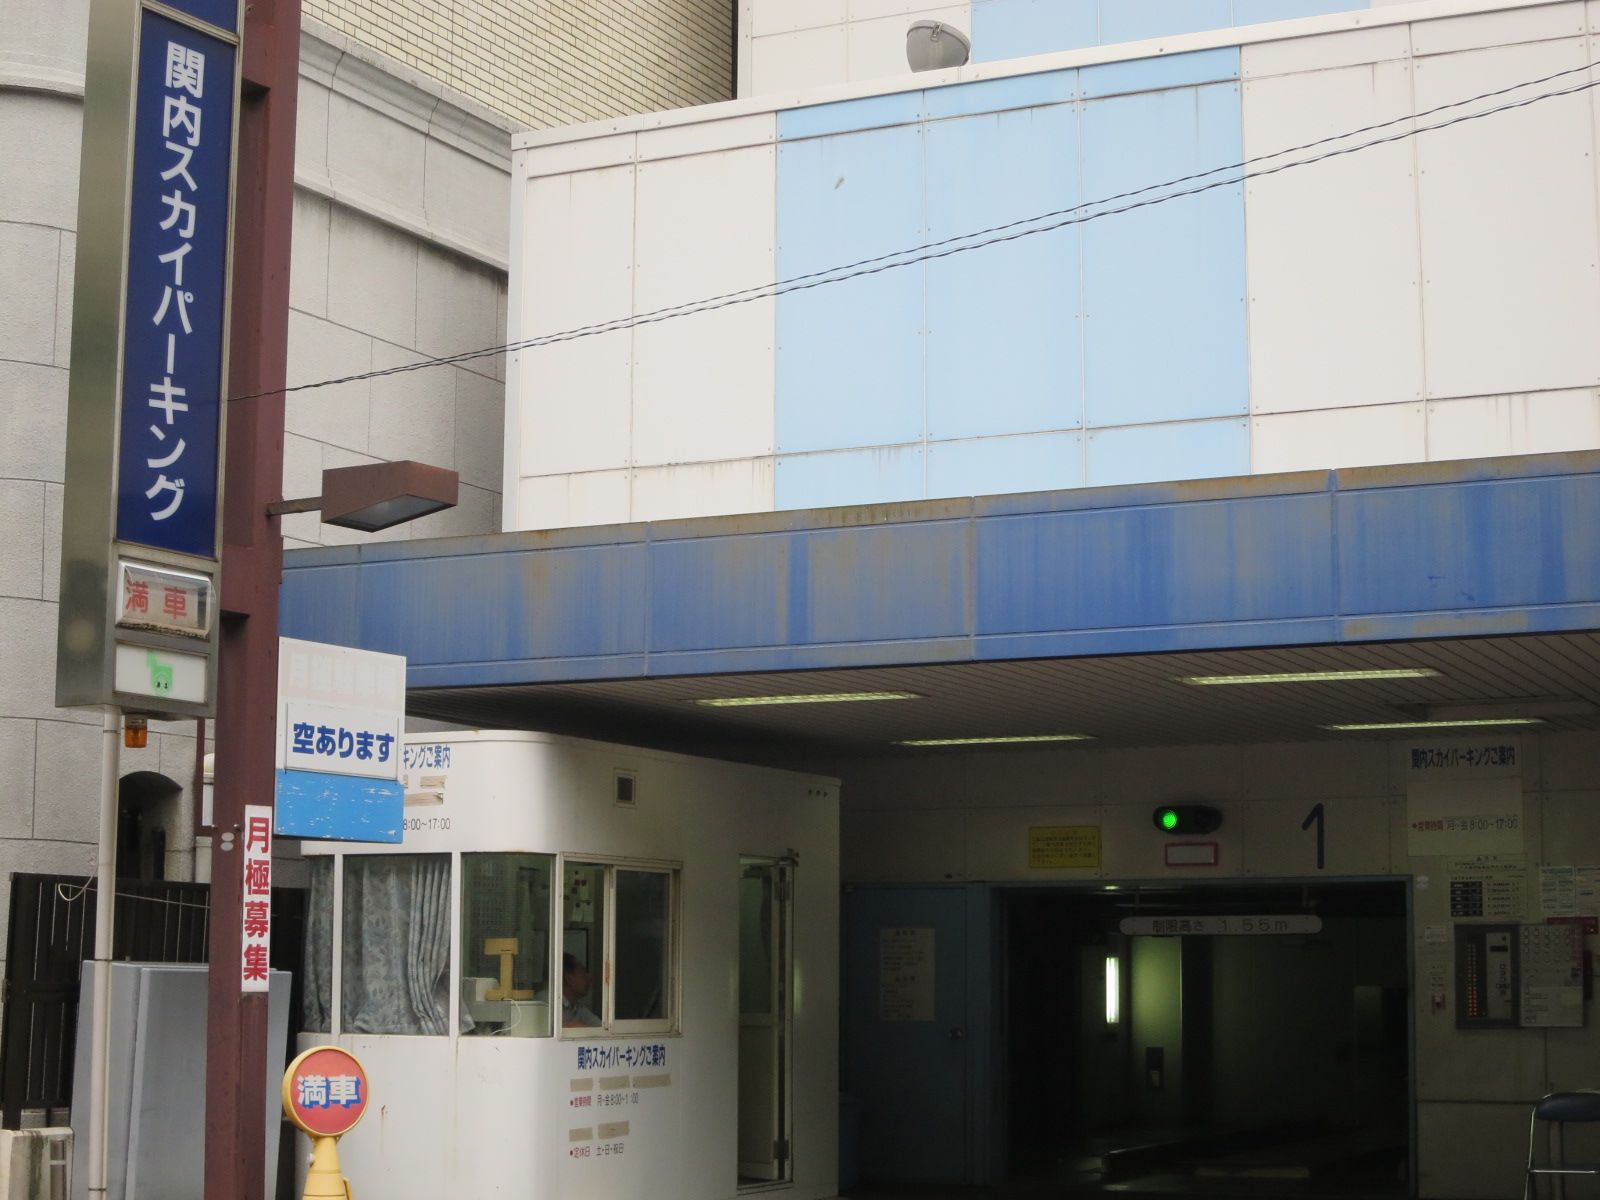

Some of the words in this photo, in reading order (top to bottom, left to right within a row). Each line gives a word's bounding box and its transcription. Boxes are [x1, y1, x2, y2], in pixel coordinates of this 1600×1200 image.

[145, 41, 206, 522] 関内スカイパーキング
[125, 578, 188, 620] 満車
[292, 721, 395, 764] 空あります
[1302, 803, 1324, 870] 1
[243, 816, 270, 982] 月極募集
[577, 1045, 666, 1070] 関内スカイパーキングご案内
[297, 1074, 361, 1109] 満車
